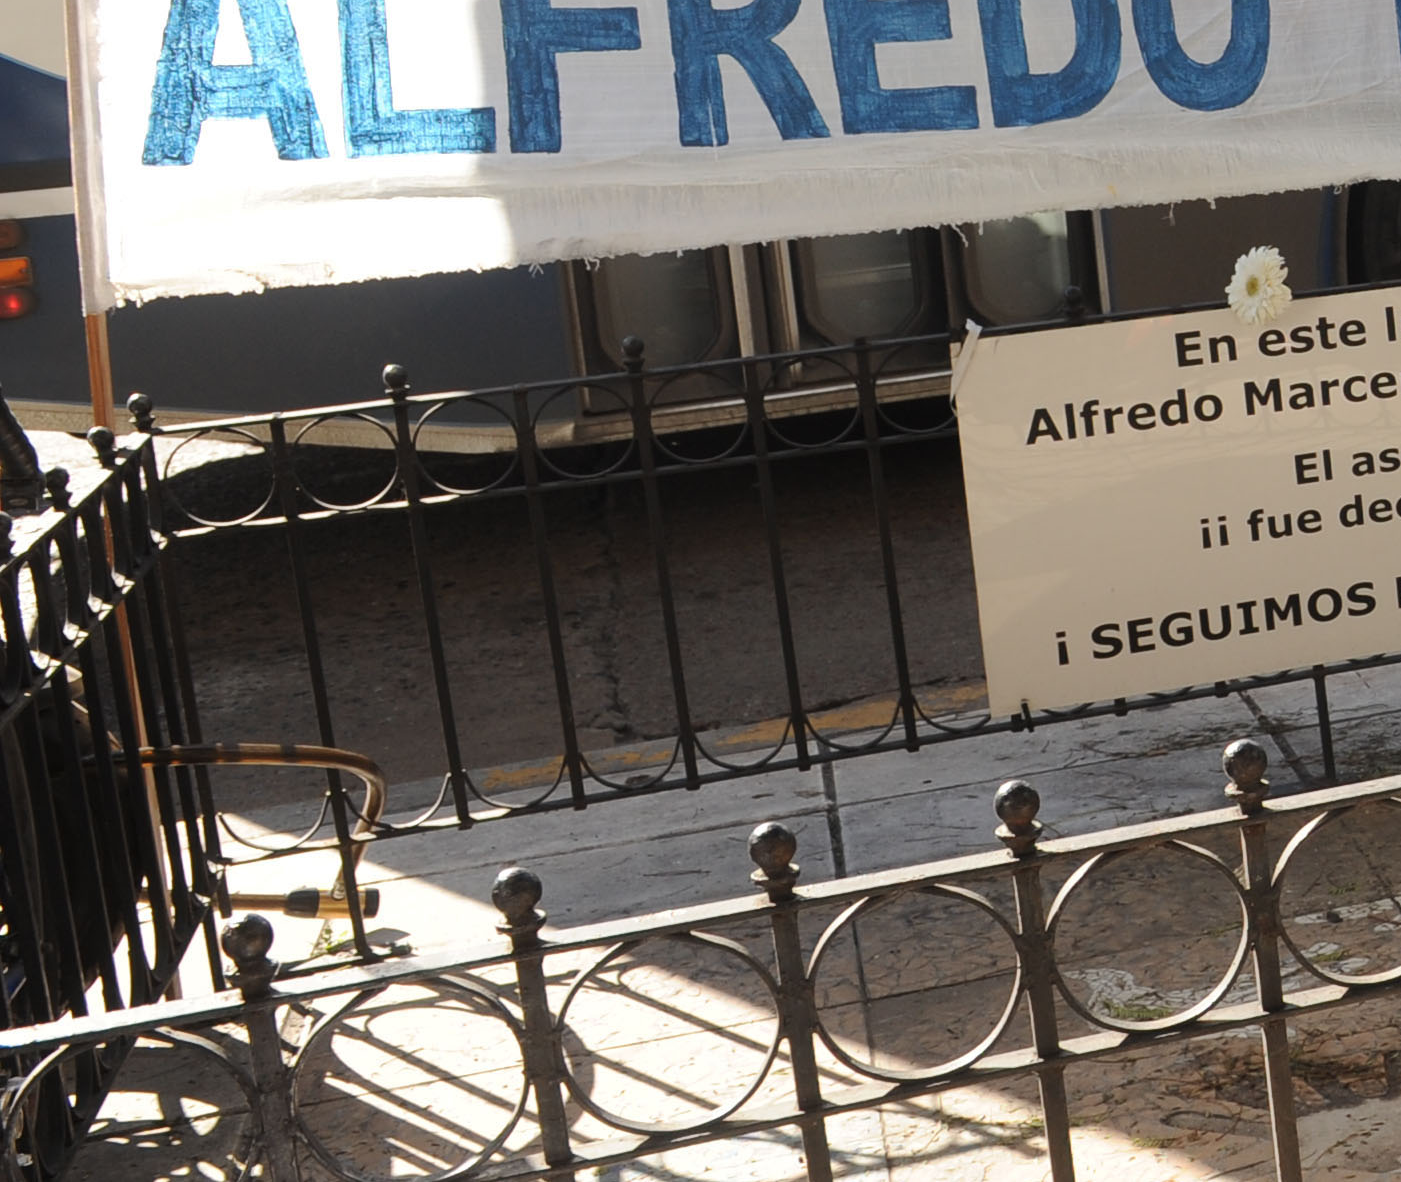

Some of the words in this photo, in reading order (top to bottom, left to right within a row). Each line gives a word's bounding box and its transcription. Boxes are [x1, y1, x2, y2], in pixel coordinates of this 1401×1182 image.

[1174, 330, 1238, 368] En
[1258, 316, 1367, 358] este
[1026, 387, 1224, 446] Alfredo
[1294, 449, 1334, 485] El
[1247, 508, 1323, 543] fue
[1090, 581, 1377, 661] SEGUIMOS
